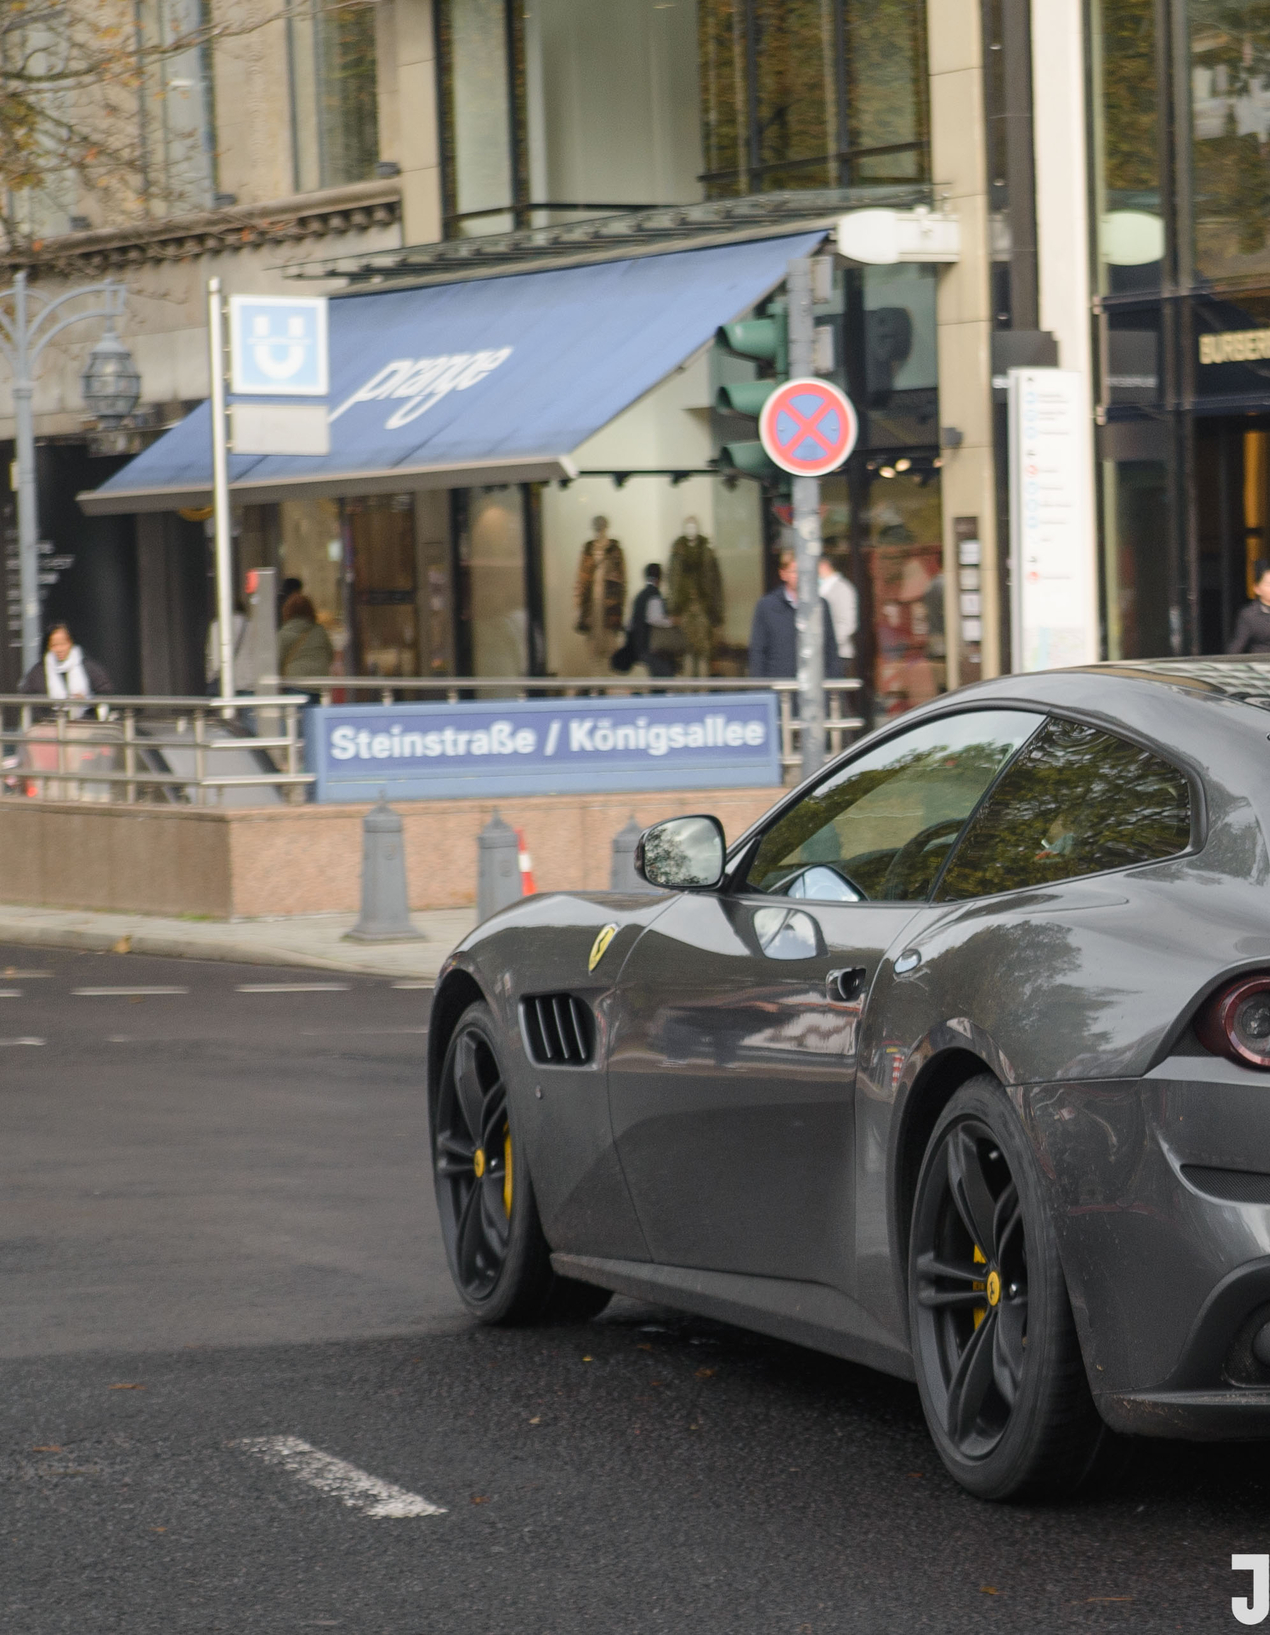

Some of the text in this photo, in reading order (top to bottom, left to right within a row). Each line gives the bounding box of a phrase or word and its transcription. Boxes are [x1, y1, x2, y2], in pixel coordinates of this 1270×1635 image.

[329, 346, 513, 430] prange
[330, 719, 536, 760] Steinstraße
[569, 713, 766, 756] Königsallee
